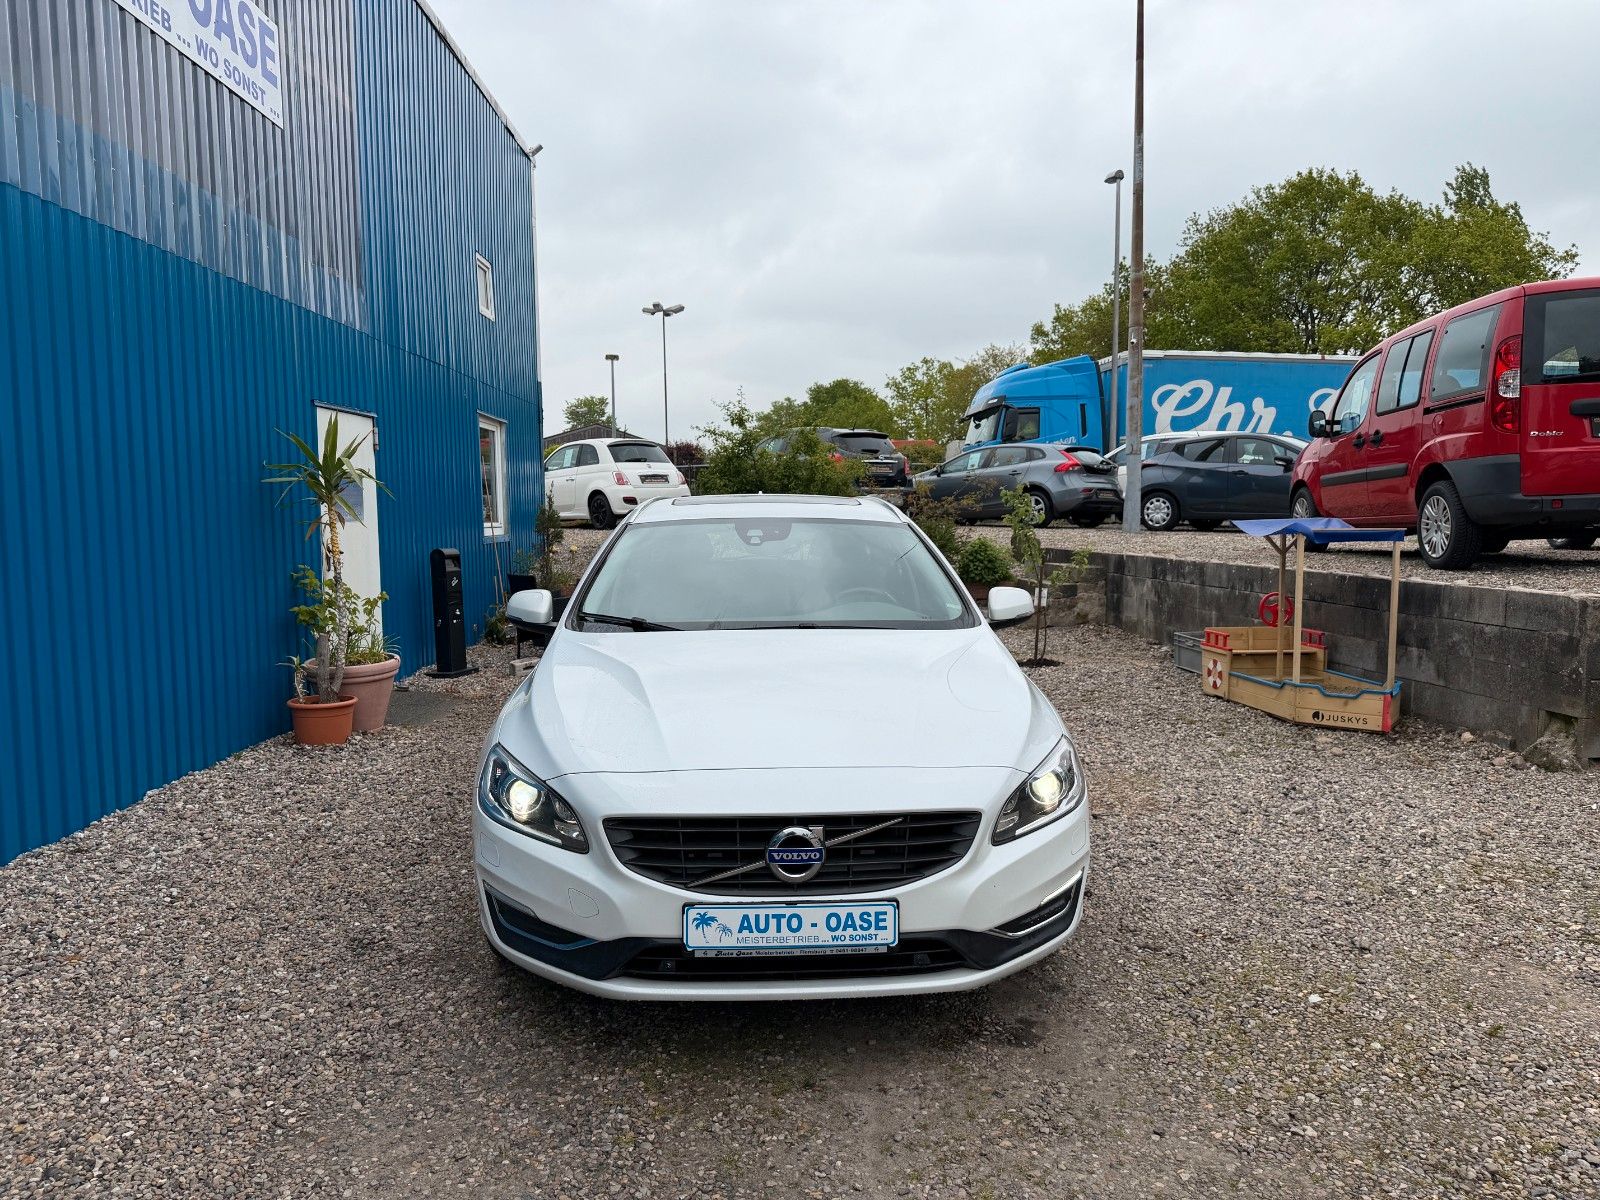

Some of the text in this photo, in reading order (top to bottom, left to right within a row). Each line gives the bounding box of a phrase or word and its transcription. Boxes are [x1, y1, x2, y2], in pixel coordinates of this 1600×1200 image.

[195, 34, 219, 68] WO
[223, 58, 266, 106] SONST
[1325, 714, 1368, 725] JUSKYS
[771, 851, 820, 860] VOLVO
[738, 913, 803, 934] AUTO
[825, 911, 888, 933] OASE
[736, 935, 820, 945] MEISTERBETRIEB
[831, 934, 847, 942] WO
[848, 933, 878, 942] SONST
